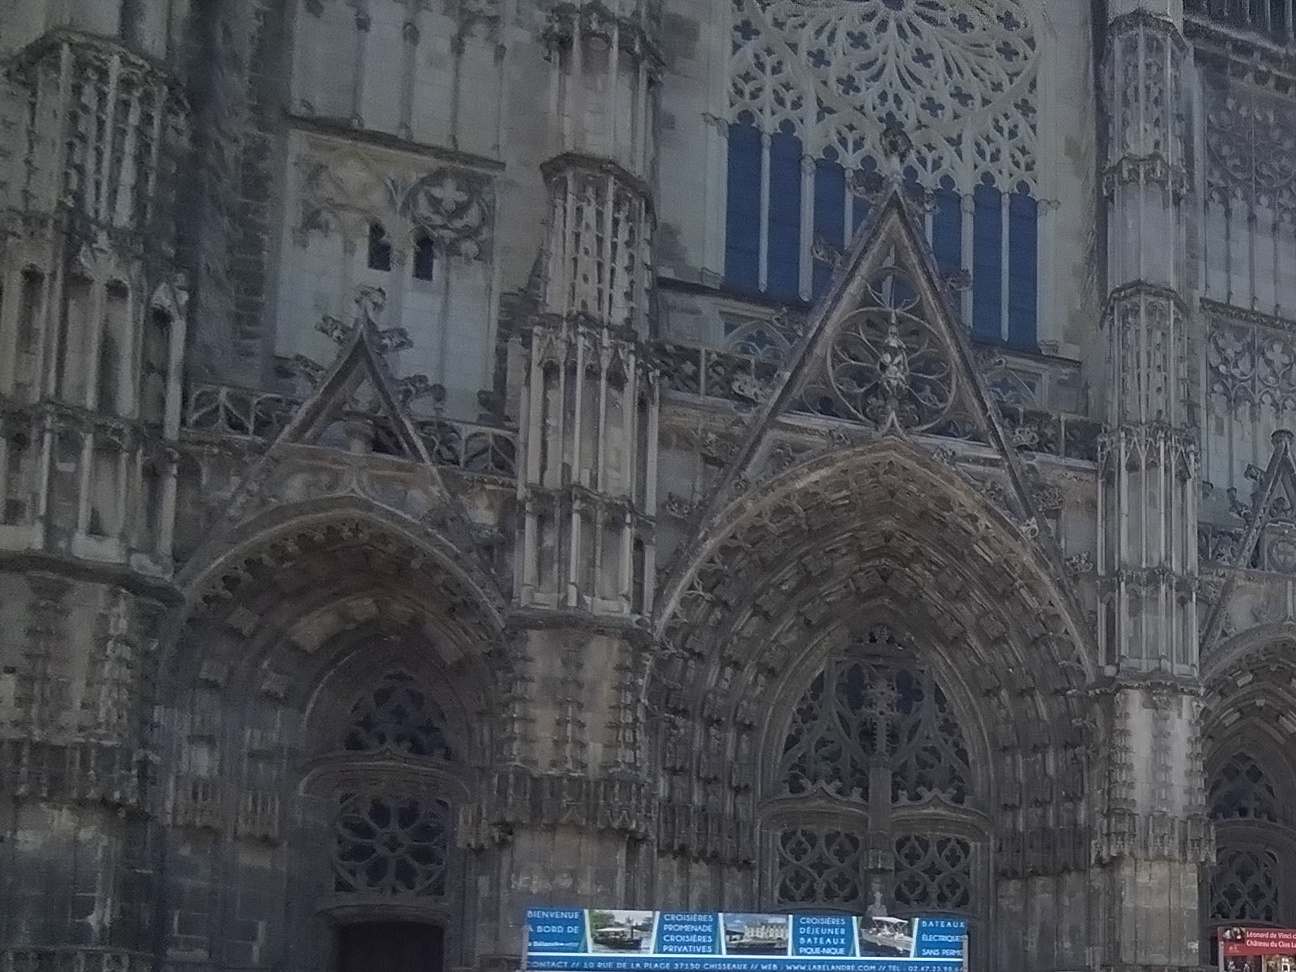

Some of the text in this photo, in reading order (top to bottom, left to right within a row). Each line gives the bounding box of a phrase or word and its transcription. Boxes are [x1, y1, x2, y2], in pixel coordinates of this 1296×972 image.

[526, 910, 580, 919] BIENVENUE
[663, 913, 713, 922] CROISIÈRES
[799, 917, 846, 925] CROISIÈRES
[921, 920, 965, 928] BATEAUX
[536, 925, 564, 933] BORD
[566, 926, 579, 934] DE
[663, 924, 713, 932] PROMENADE
[799, 926, 846, 935] DÉJEUNER
[663, 934, 712, 942] CROISIÈRES
[662, 945, 712, 953] PRIVATIVES
[799, 947, 845, 955] PIQUE-NIQUE
[921, 948, 940, 956] SANS
[644, 962, 671, 970] PLAGE
